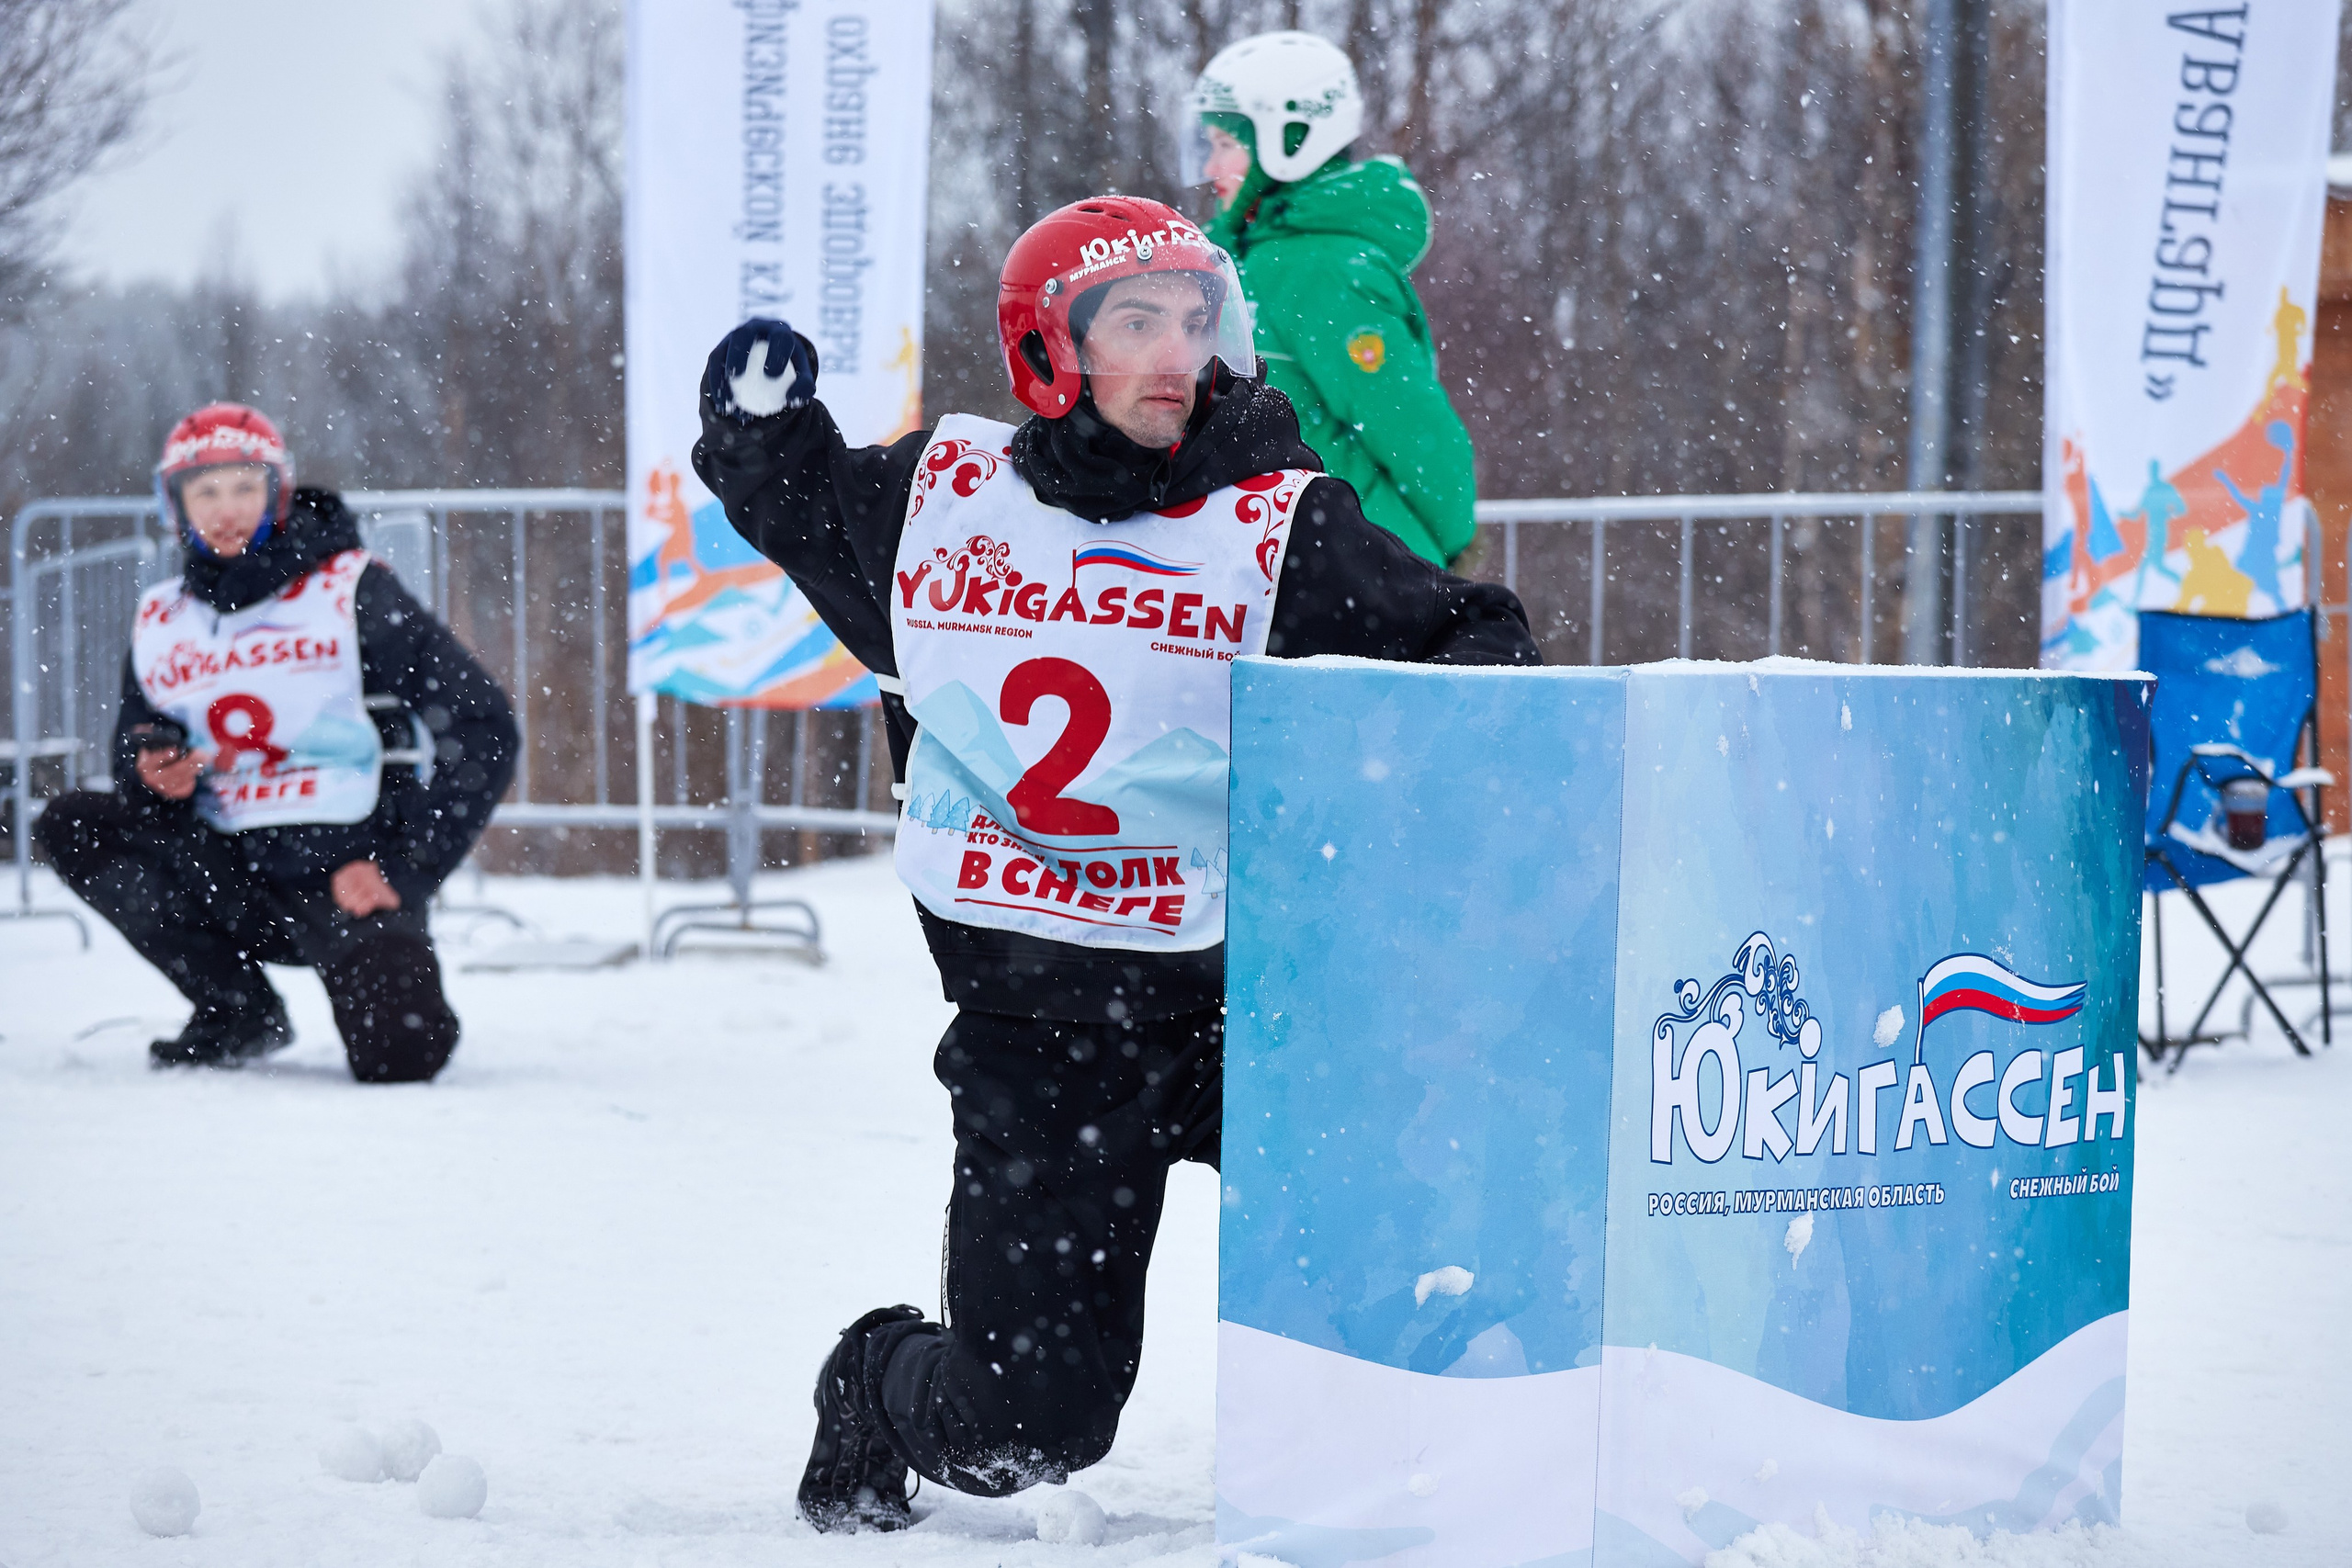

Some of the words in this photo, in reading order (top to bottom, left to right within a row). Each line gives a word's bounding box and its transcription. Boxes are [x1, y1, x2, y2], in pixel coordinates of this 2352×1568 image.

[1069, 254, 1127, 283] МУРМАНСК
[906, 617, 935, 630] RUSSIA,
[937, 621, 993, 634] MURMANSK
[994, 626, 1033, 638] REGION
[1150, 641, 1215, 660] СНЕЖНЫЙ
[1216, 650, 1241, 661] БО
[1000, 656, 1120, 836] 2
[967, 831, 1000, 845] КТО
[956, 850, 993, 889] В
[1057, 856, 1186, 889] ТОЛК
[2008, 1166, 2089, 1200] СНЕЖНЫЙ
[2087, 1163, 2120, 1194] БОЙ
[1647, 1190, 1730, 1217] РОССИЯ,
[1733, 1186, 1865, 1213] МУРМАНСКАЯ
[1867, 1181, 1946, 1208] ОБЛАСТЬ
